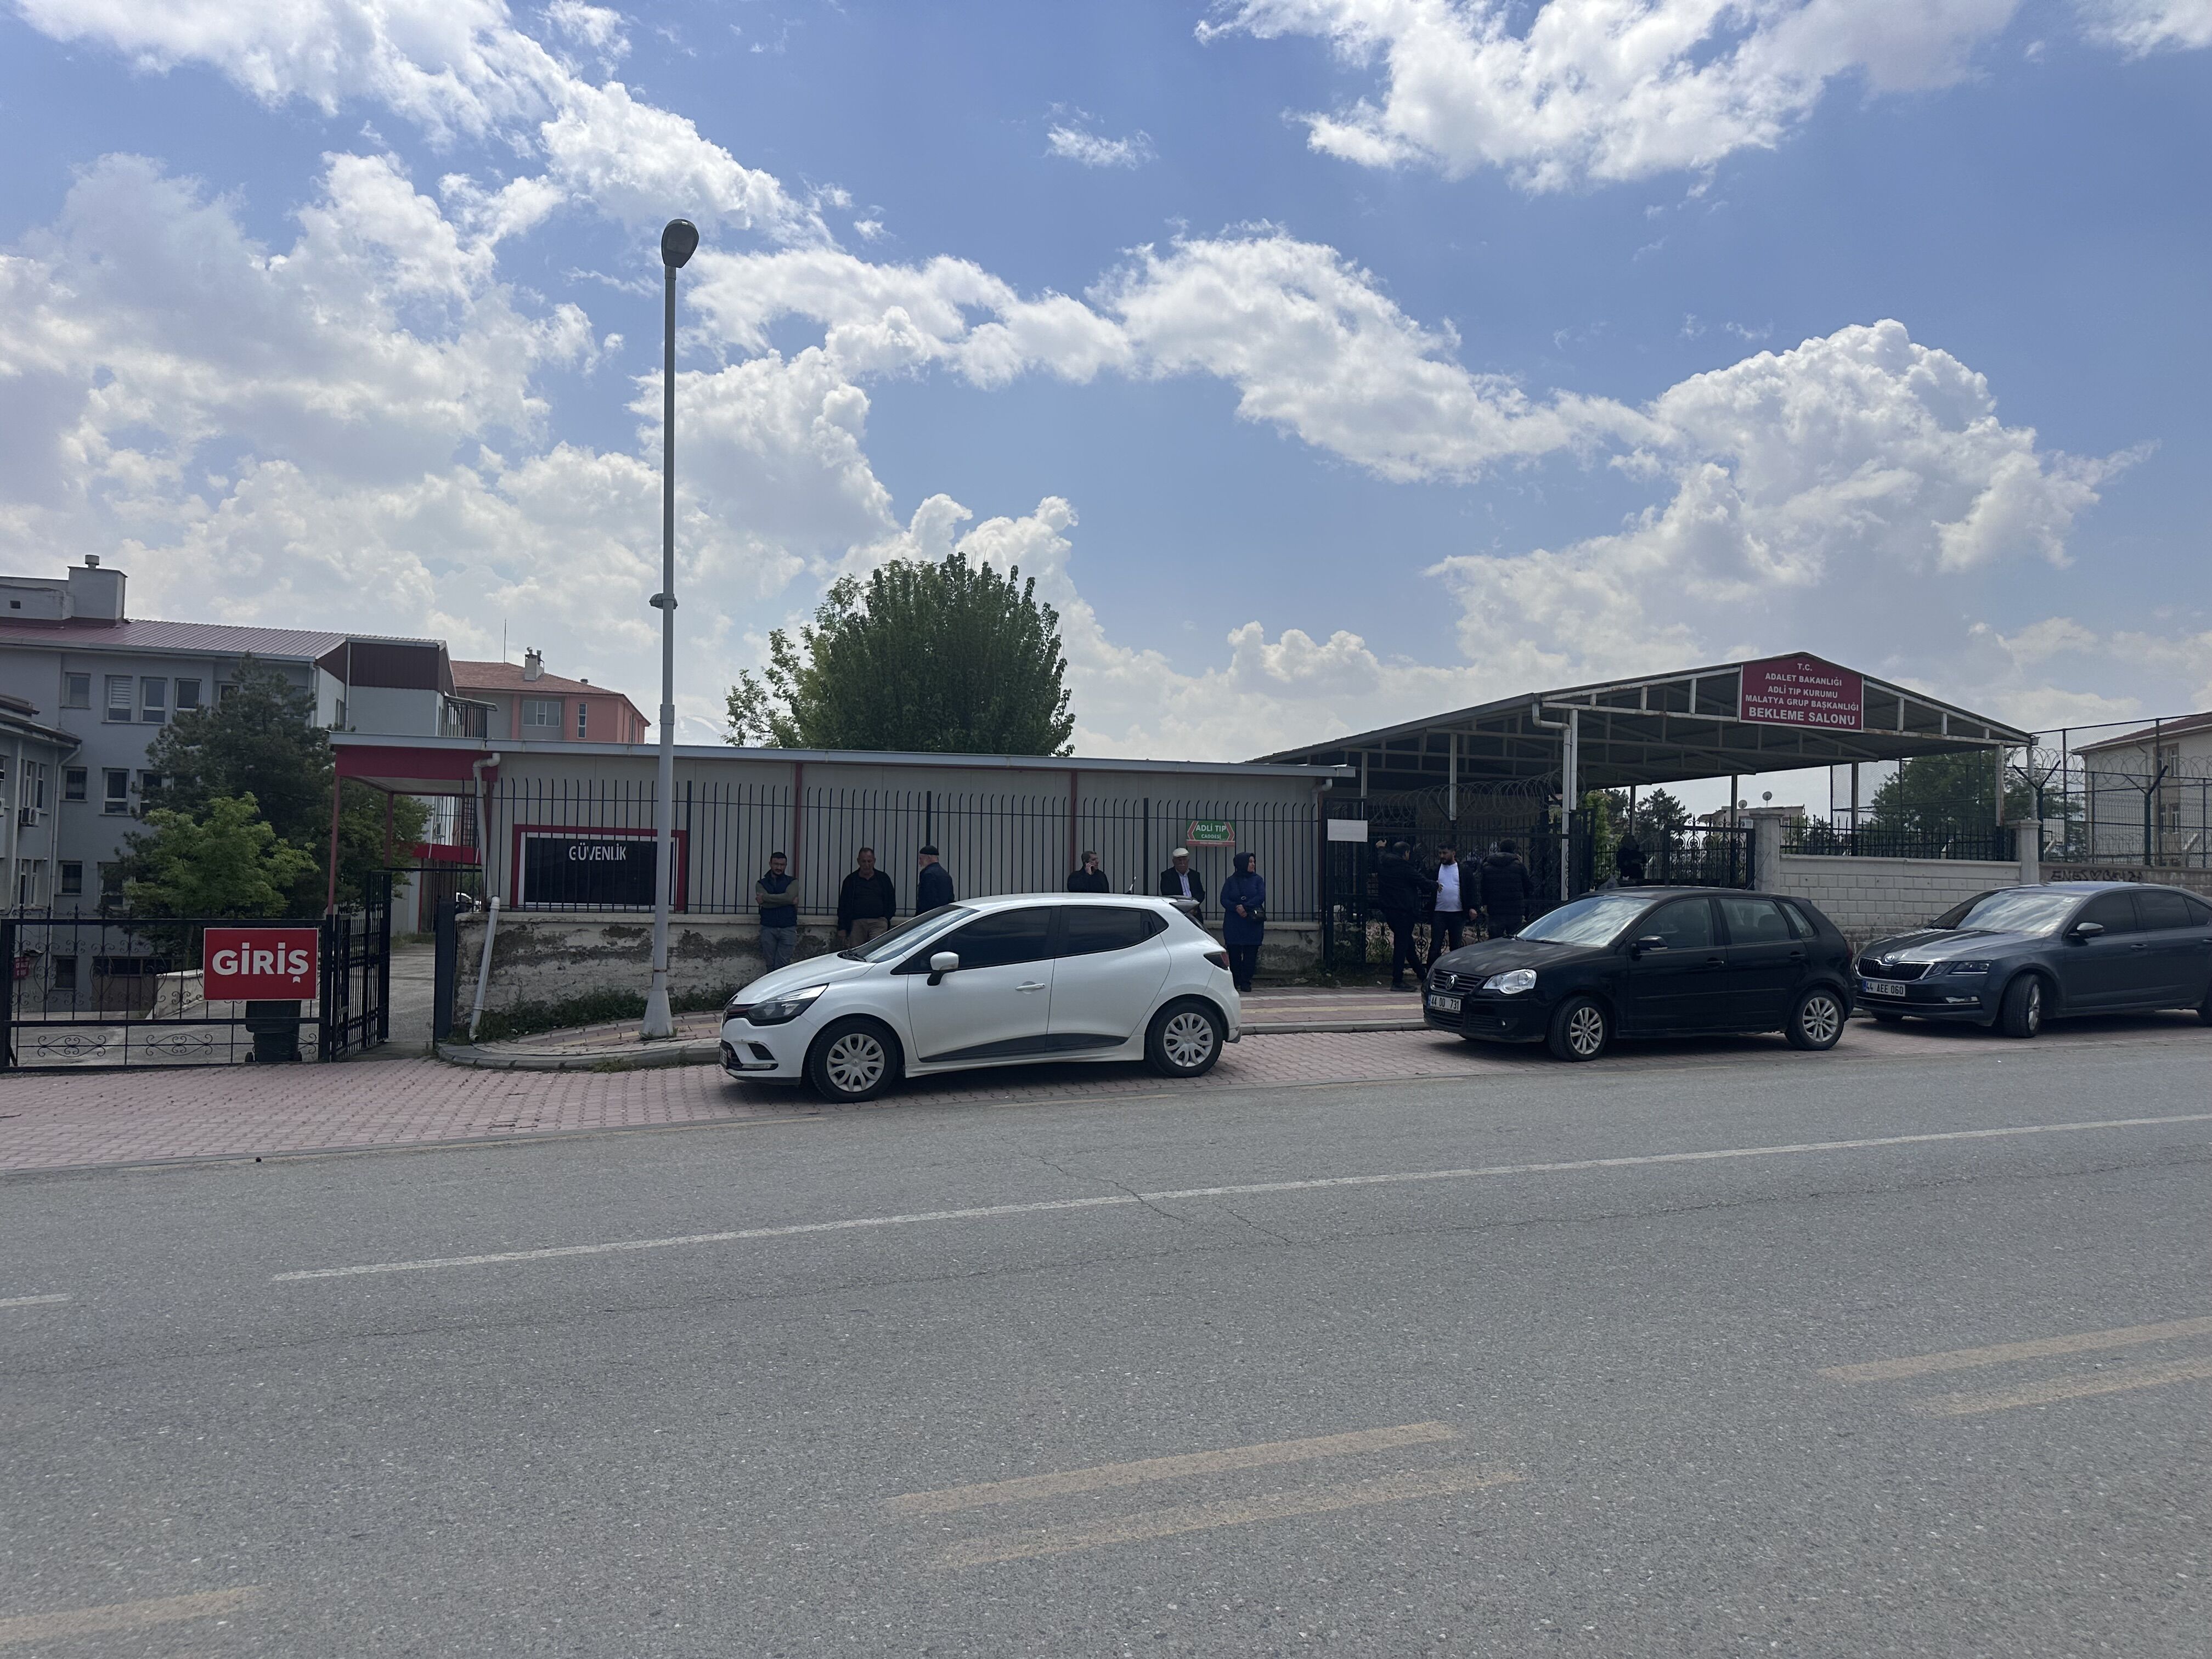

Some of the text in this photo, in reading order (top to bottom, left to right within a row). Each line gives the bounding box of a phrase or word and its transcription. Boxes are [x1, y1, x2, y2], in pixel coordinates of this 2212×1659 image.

[1797, 663, 1813, 672] T.C.
[1765, 673, 1842, 686] ADALET BAKANLIĞI
[1768, 684, 1786, 694] ADLİ
[1803, 689, 1838, 698] KURUMU
[1745, 695, 1859, 711] MALATYA GRUP BAŞKANLIĞI
[1749, 707, 1855, 725] BEKLEME SALONU
[1195, 823, 1213, 832] ADLİ
[568, 842, 627, 861] GÜVENLİK
[212, 942, 309, 983] GİRİŞ
[1866, 982, 1904, 995] 44 AEE 060
[1431, 996, 1437, 1006] 44
[1451, 999, 1459, 1010] 731
